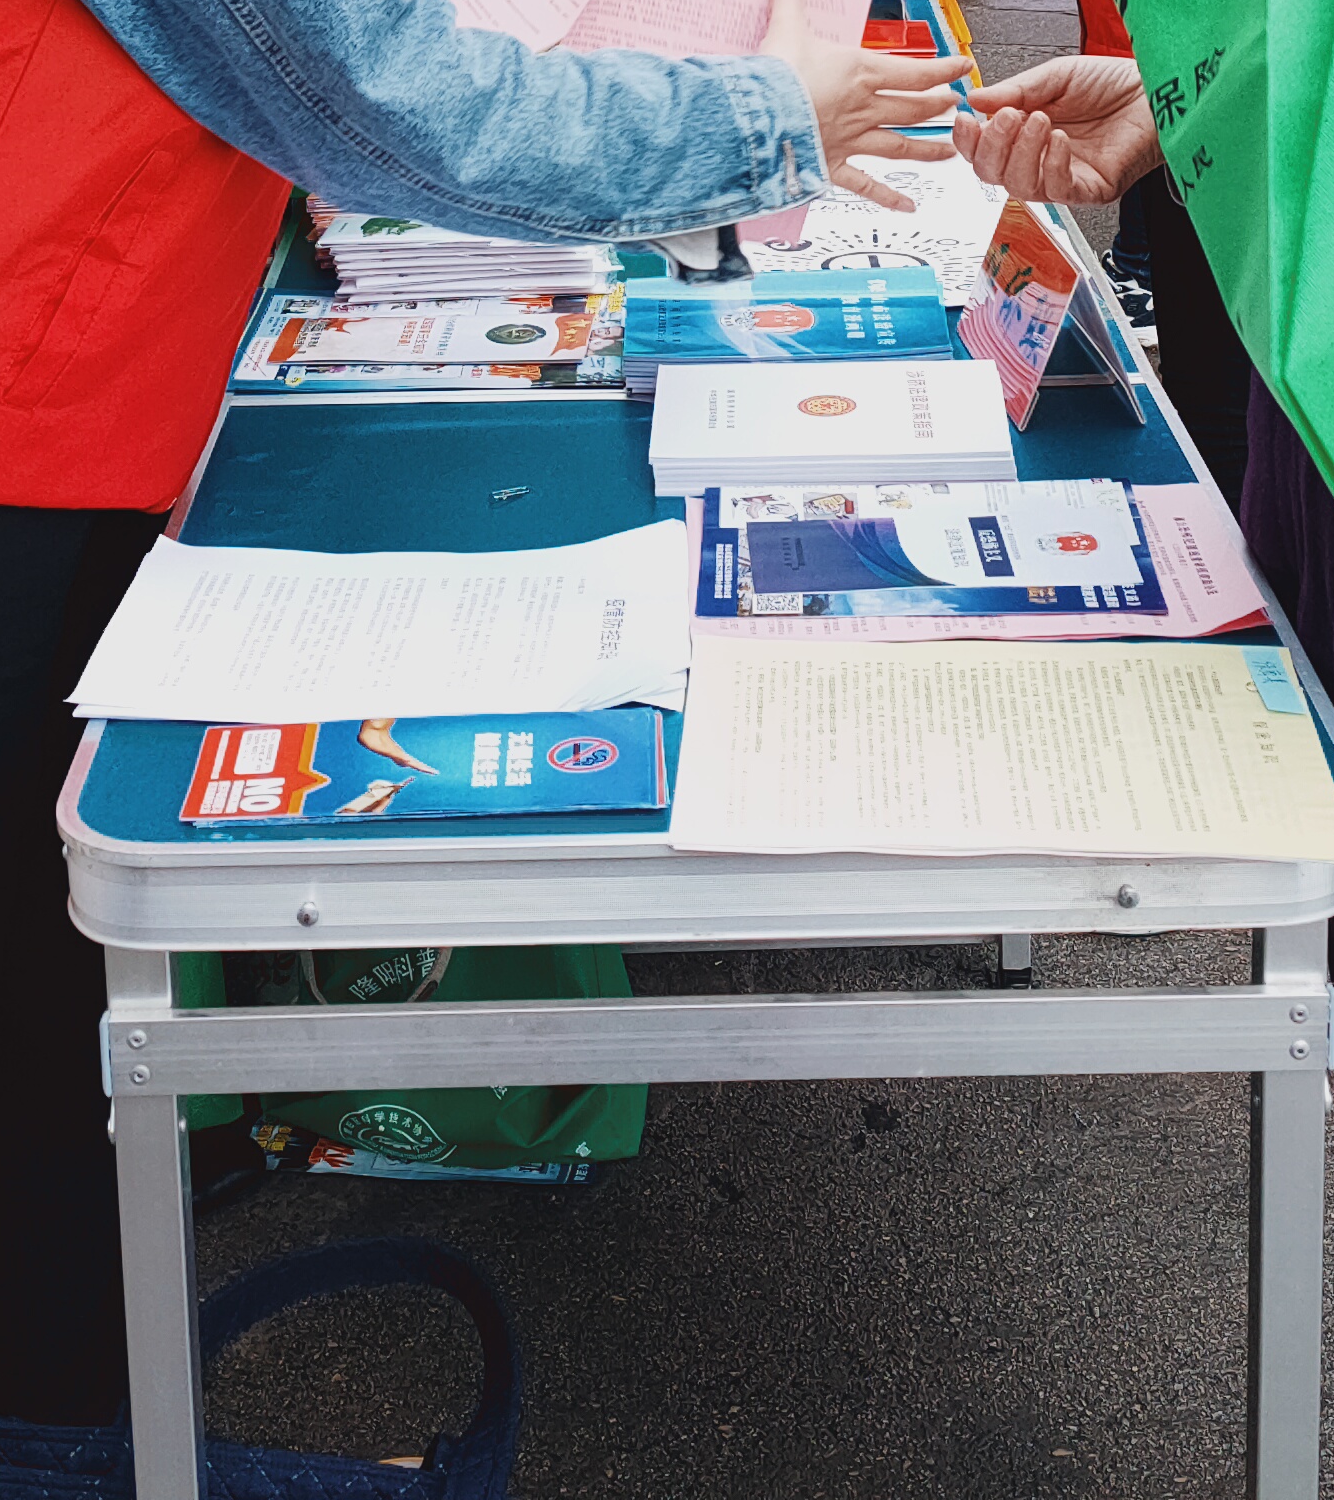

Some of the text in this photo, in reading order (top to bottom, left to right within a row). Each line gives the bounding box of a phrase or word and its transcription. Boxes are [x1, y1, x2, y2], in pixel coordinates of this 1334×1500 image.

[596, 597, 628, 661] 疫情防控知识
[239, 777, 286, 813] NO
[349, 947, 436, 1001] 隆阳科普
